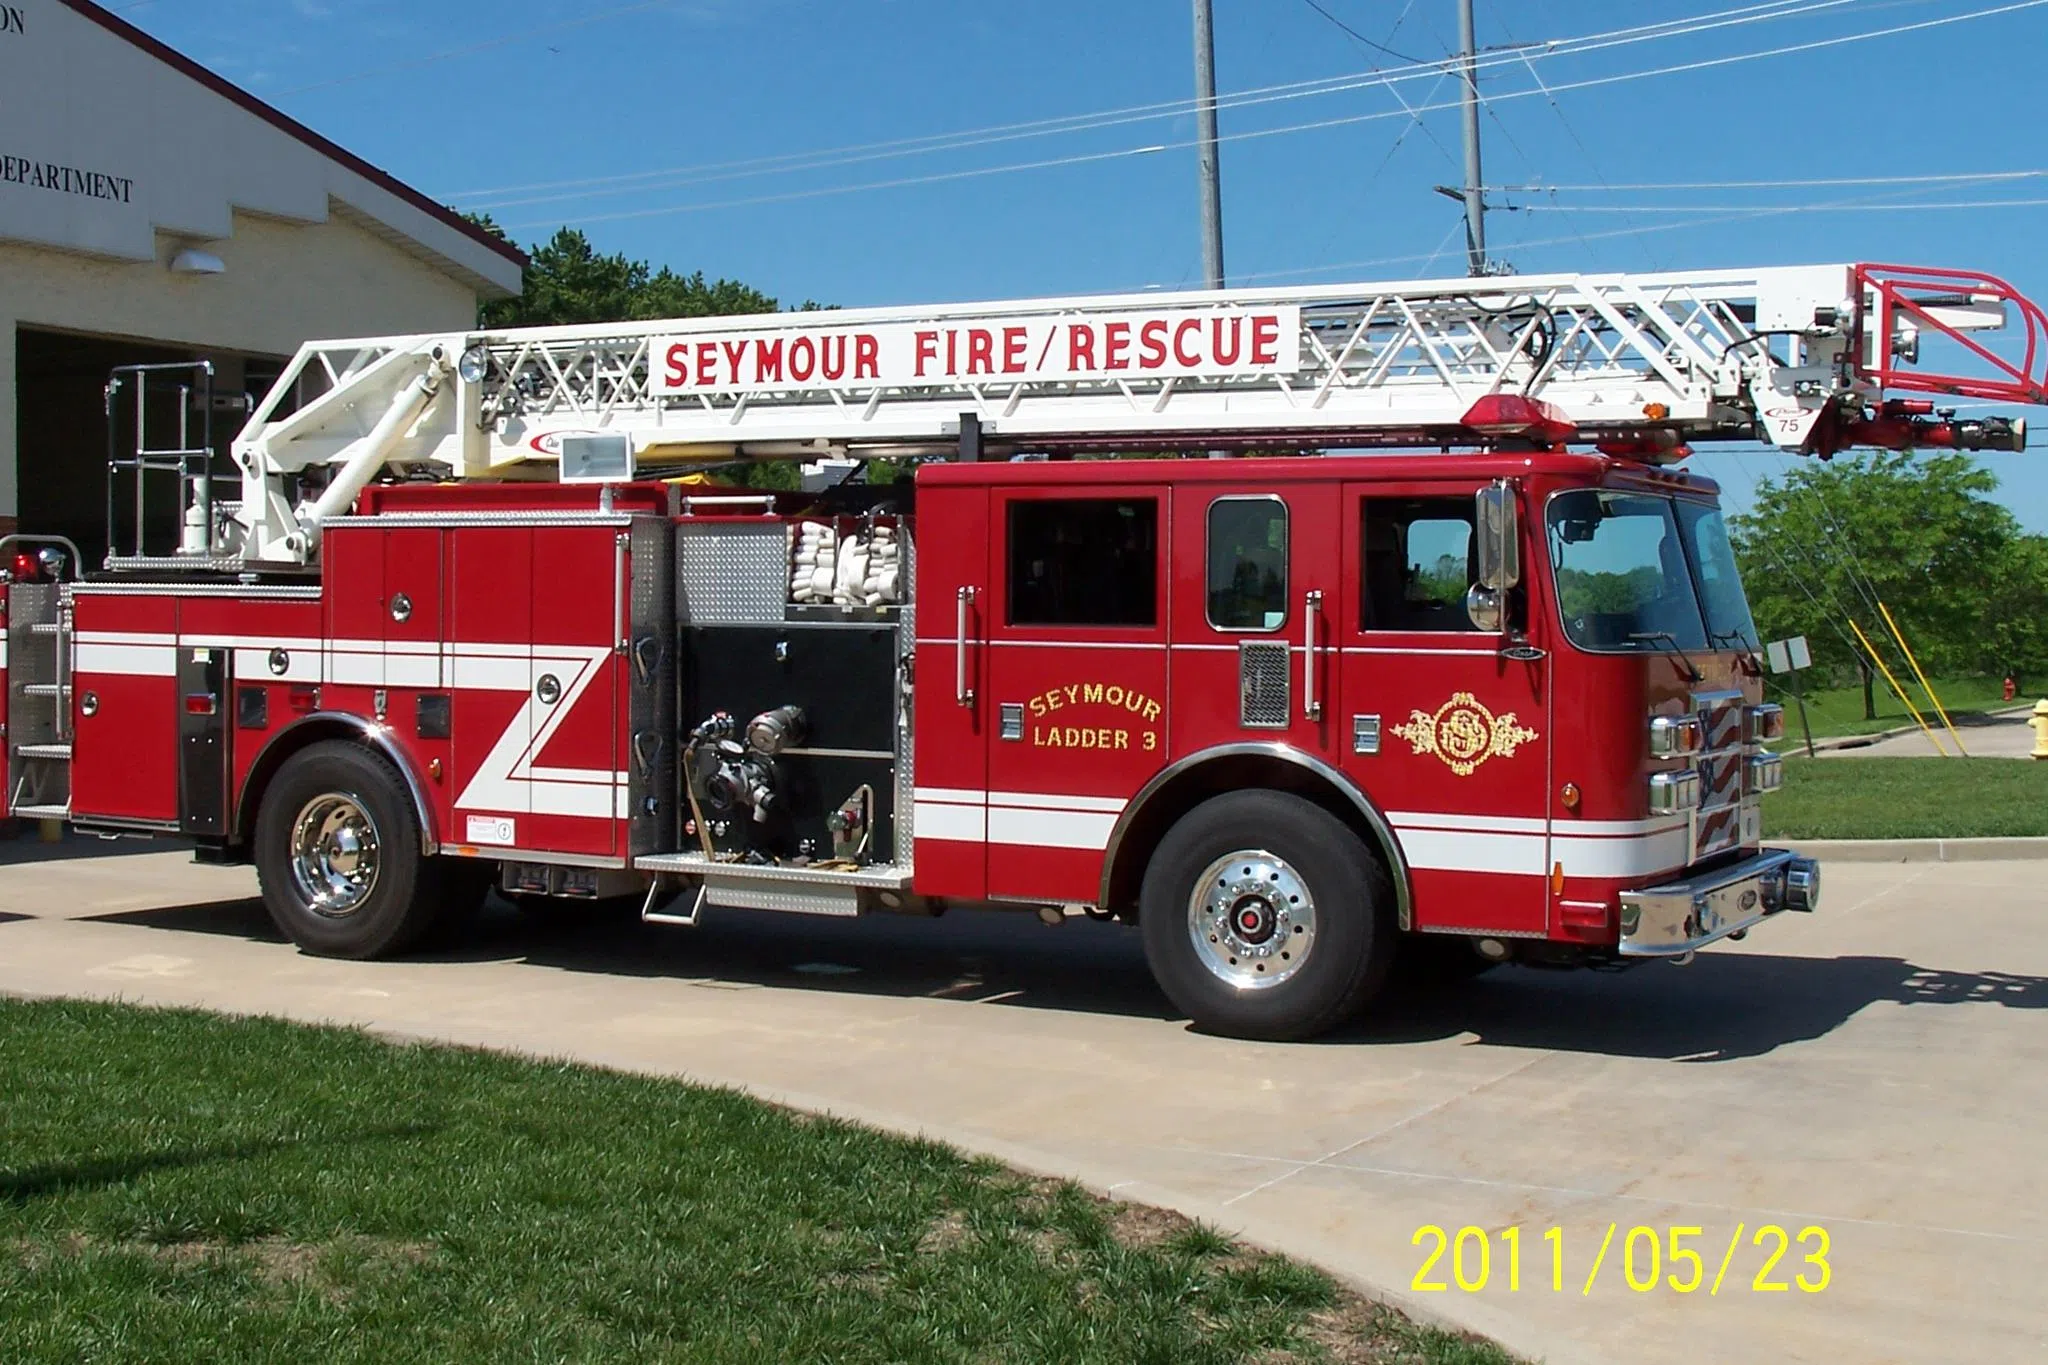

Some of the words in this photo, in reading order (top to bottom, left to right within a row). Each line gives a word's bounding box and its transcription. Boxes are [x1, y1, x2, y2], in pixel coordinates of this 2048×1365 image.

[0, 154, 133, 203] EPARTMENT
[665, 333, 881, 388] SEYMOUR
[913, 315, 1279, 377] FIRE/RESCUE
[1779, 418, 1799, 432] 75
[1029, 683, 1162, 722] SEYMOUR
[1033, 726, 1129, 750] LADDER
[1142, 731, 1157, 751] 3
